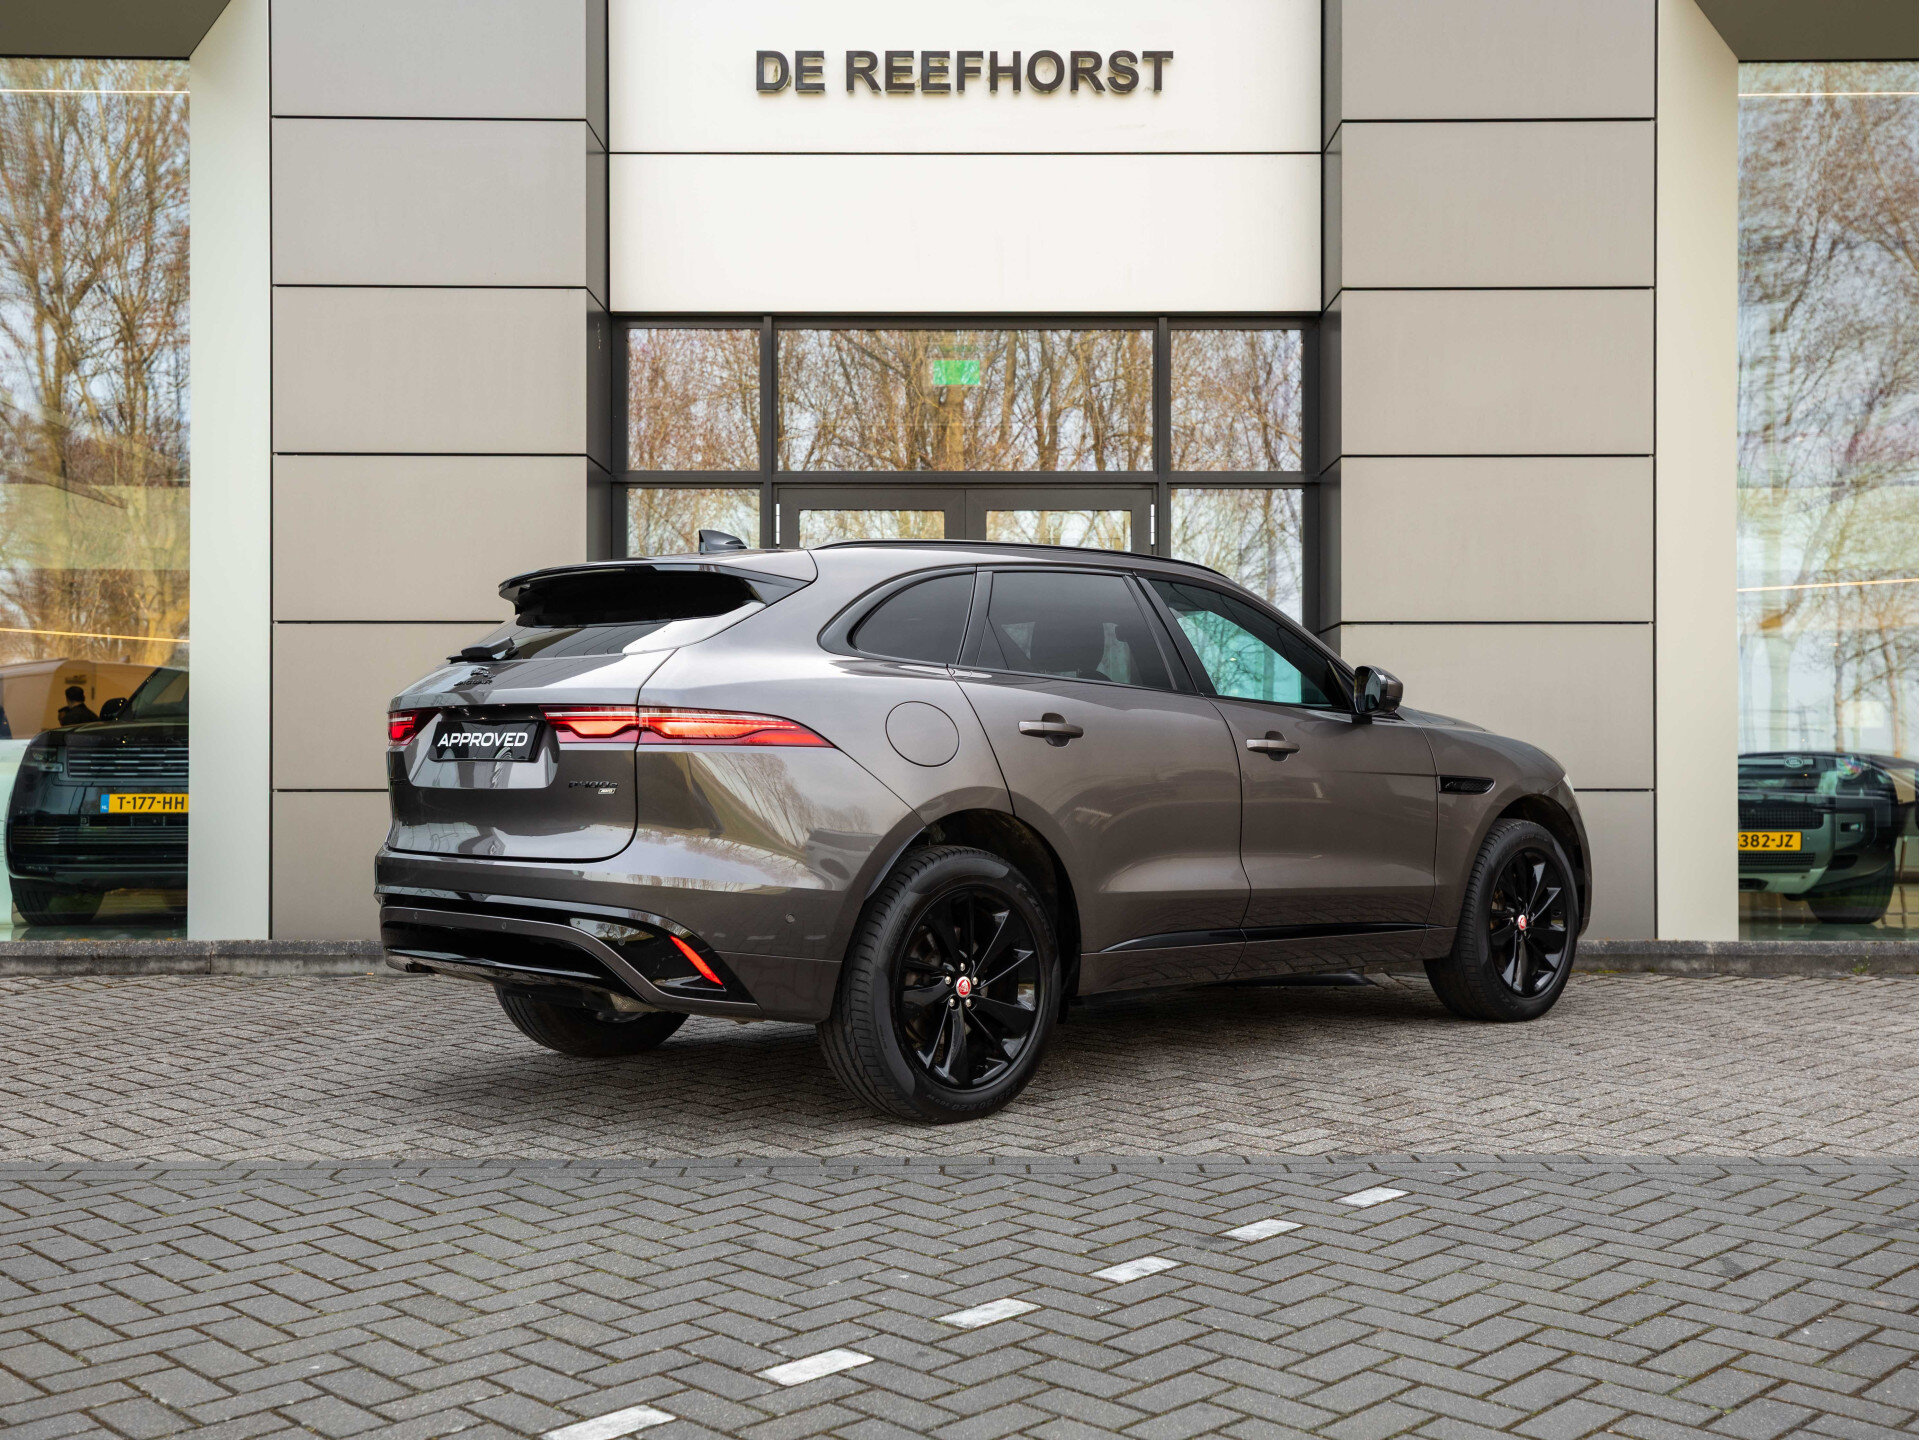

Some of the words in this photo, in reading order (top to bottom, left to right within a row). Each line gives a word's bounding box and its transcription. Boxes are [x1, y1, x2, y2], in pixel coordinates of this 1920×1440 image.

[756, 50, 825, 93] DE
[845, 50, 1174, 93] REEFHORST
[437, 732, 529, 747] APPROVED
[117, 796, 185, 810] T-177-HH
[1738, 834, 1794, 848] 382-JZ
